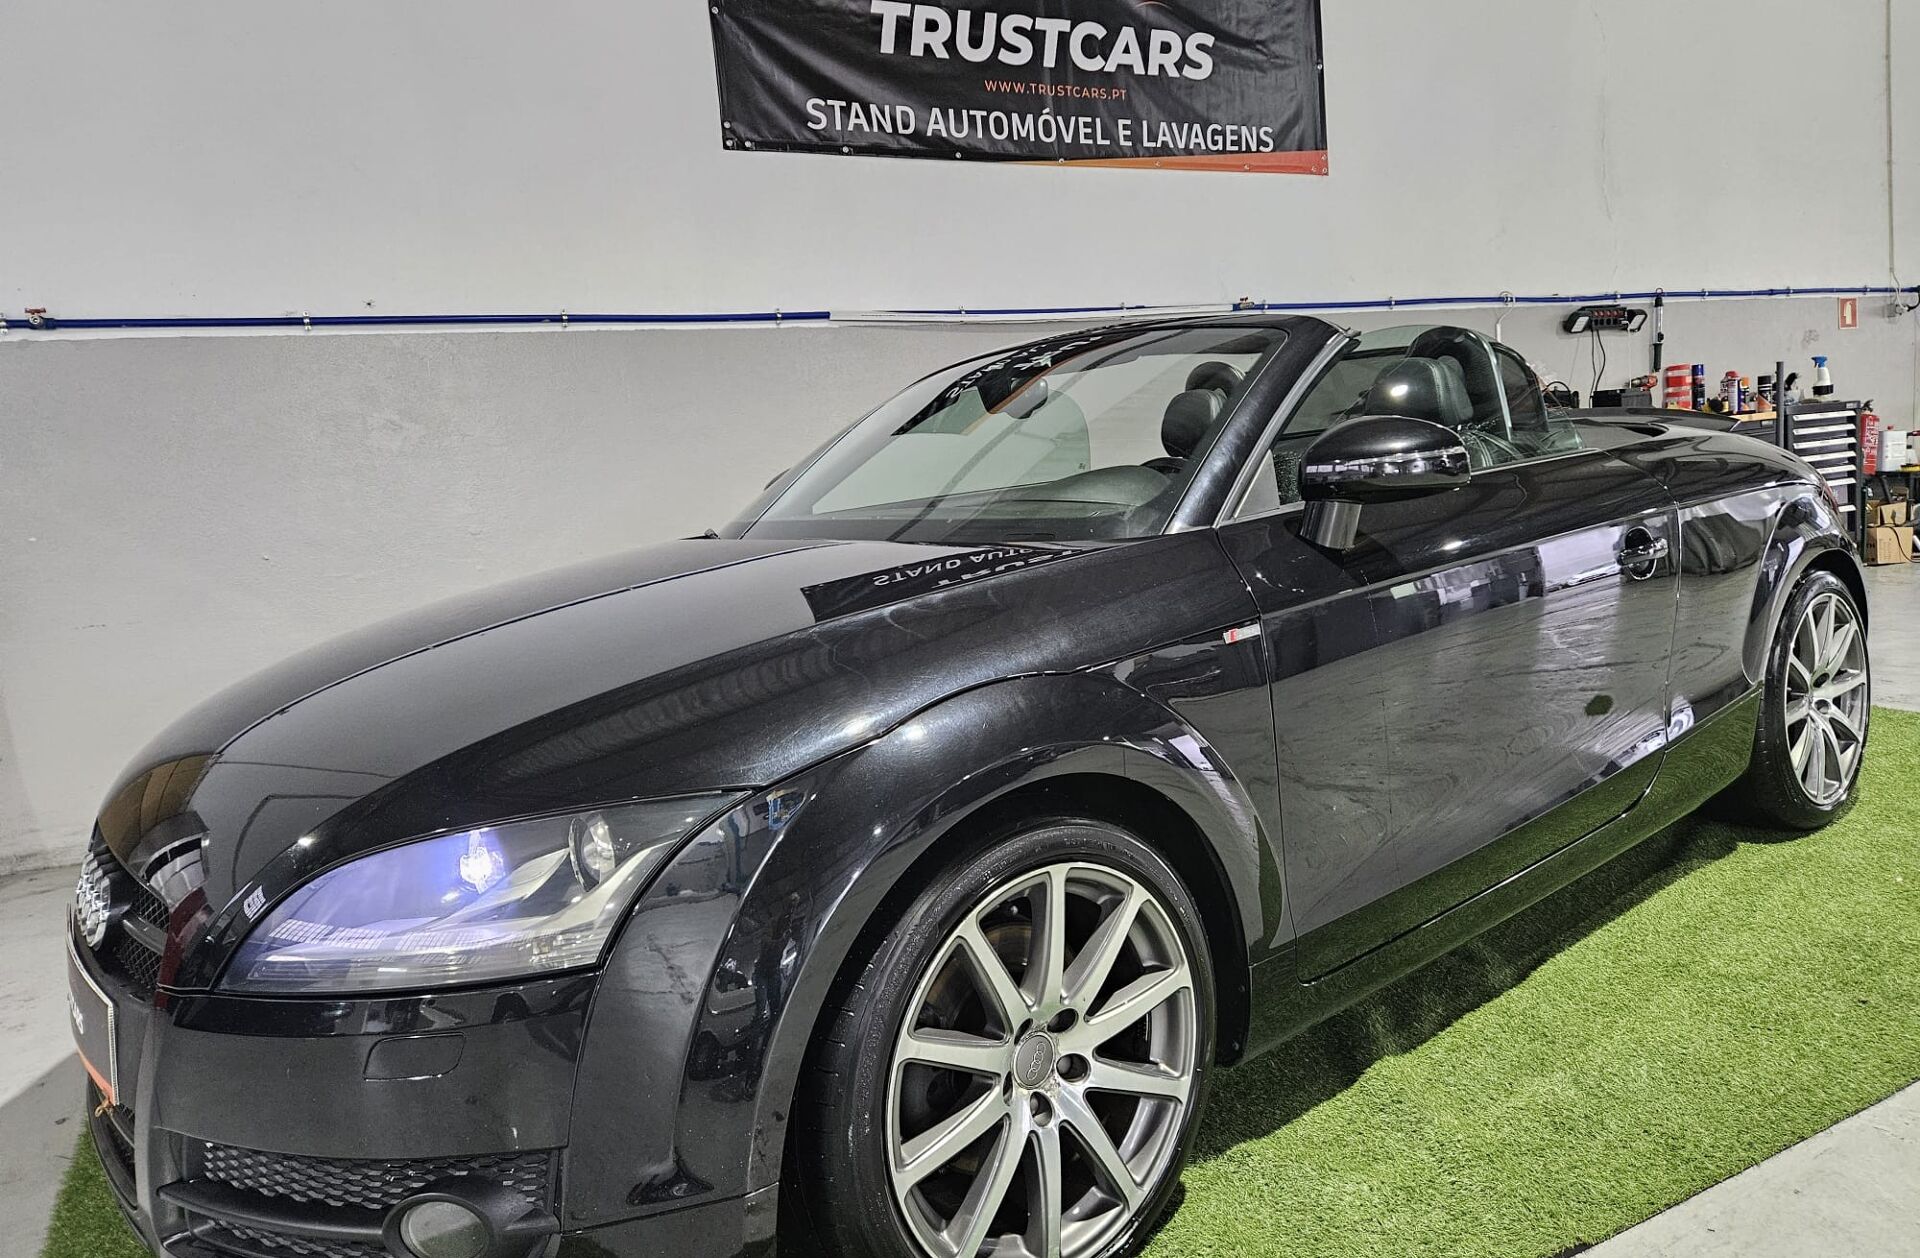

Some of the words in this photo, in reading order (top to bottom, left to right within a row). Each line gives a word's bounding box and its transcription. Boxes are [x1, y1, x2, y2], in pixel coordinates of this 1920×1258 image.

[870, 0, 1216, 80] TRUSTCARS
[984, 79, 1128, 101] WWW.TRUSTCARS.PT
[806, 97, 916, 135] STAND
[926, 107, 1111, 146] AUTOMÓVEL
[1117, 119, 1133, 147] E
[1142, 120, 1274, 153] LAVAGENS
